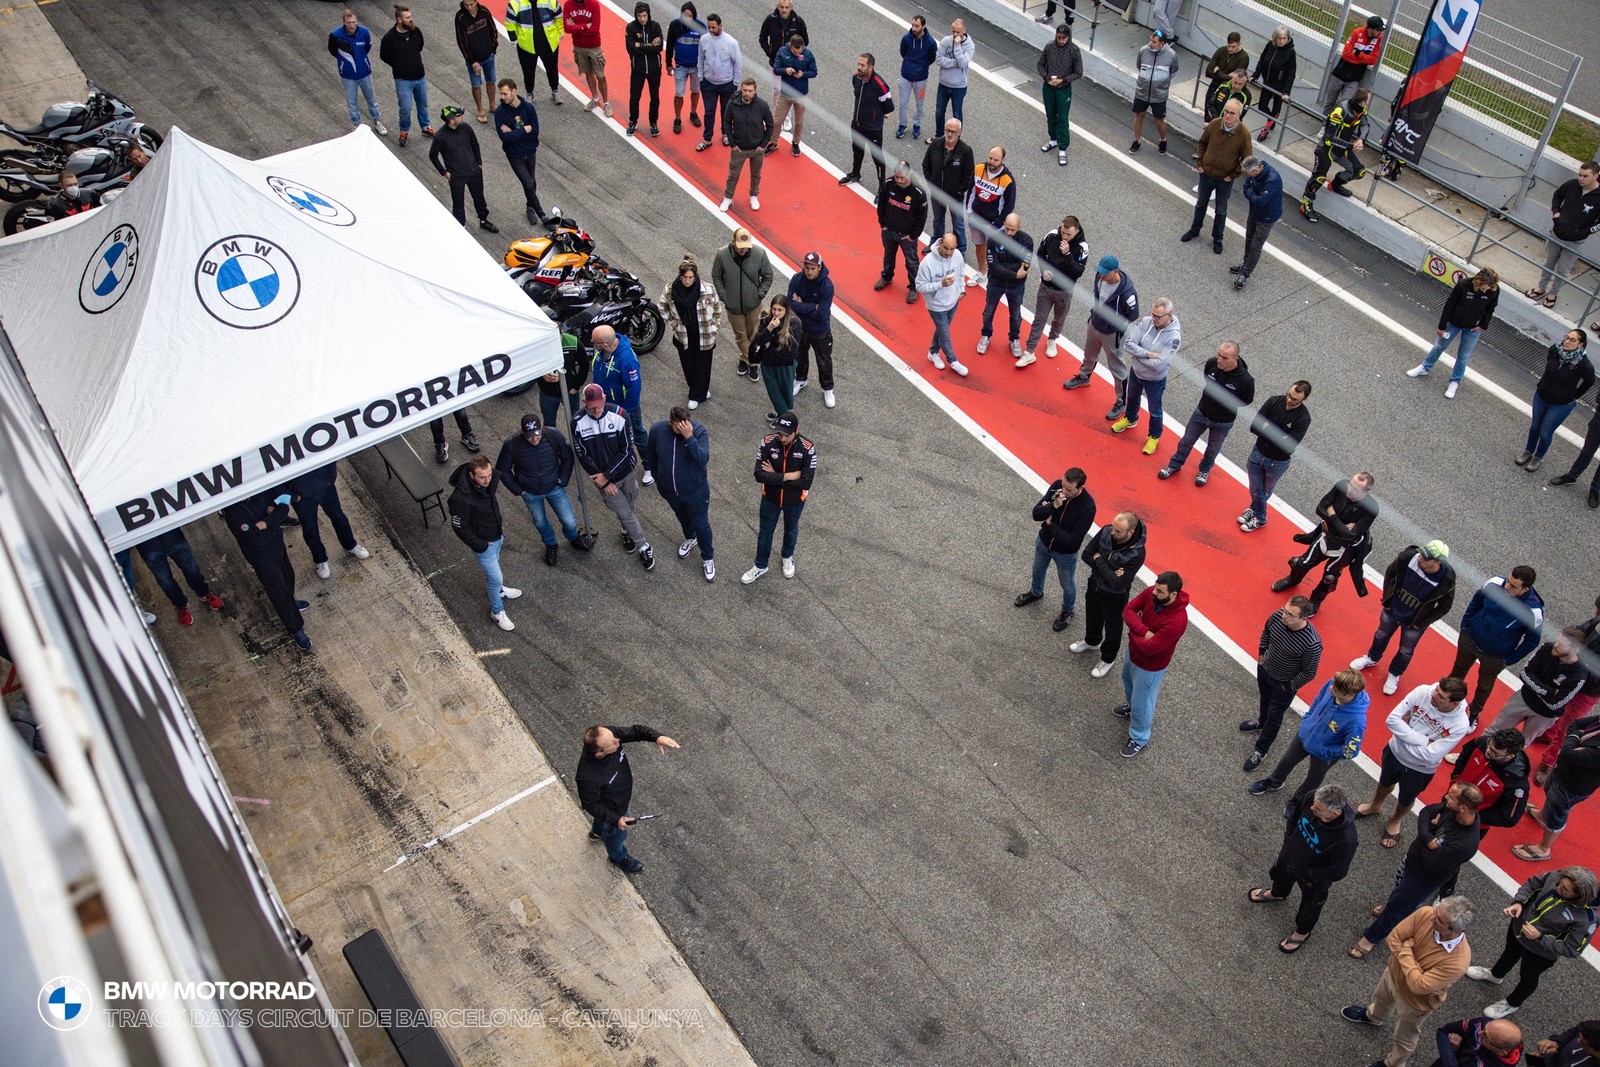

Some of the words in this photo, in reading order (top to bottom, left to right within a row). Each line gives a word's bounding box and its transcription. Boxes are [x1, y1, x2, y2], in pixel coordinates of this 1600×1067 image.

[201, 240, 273, 277] BMW
[115, 455, 244, 533] BMW
[257, 353, 513, 474] MOTORRAD
